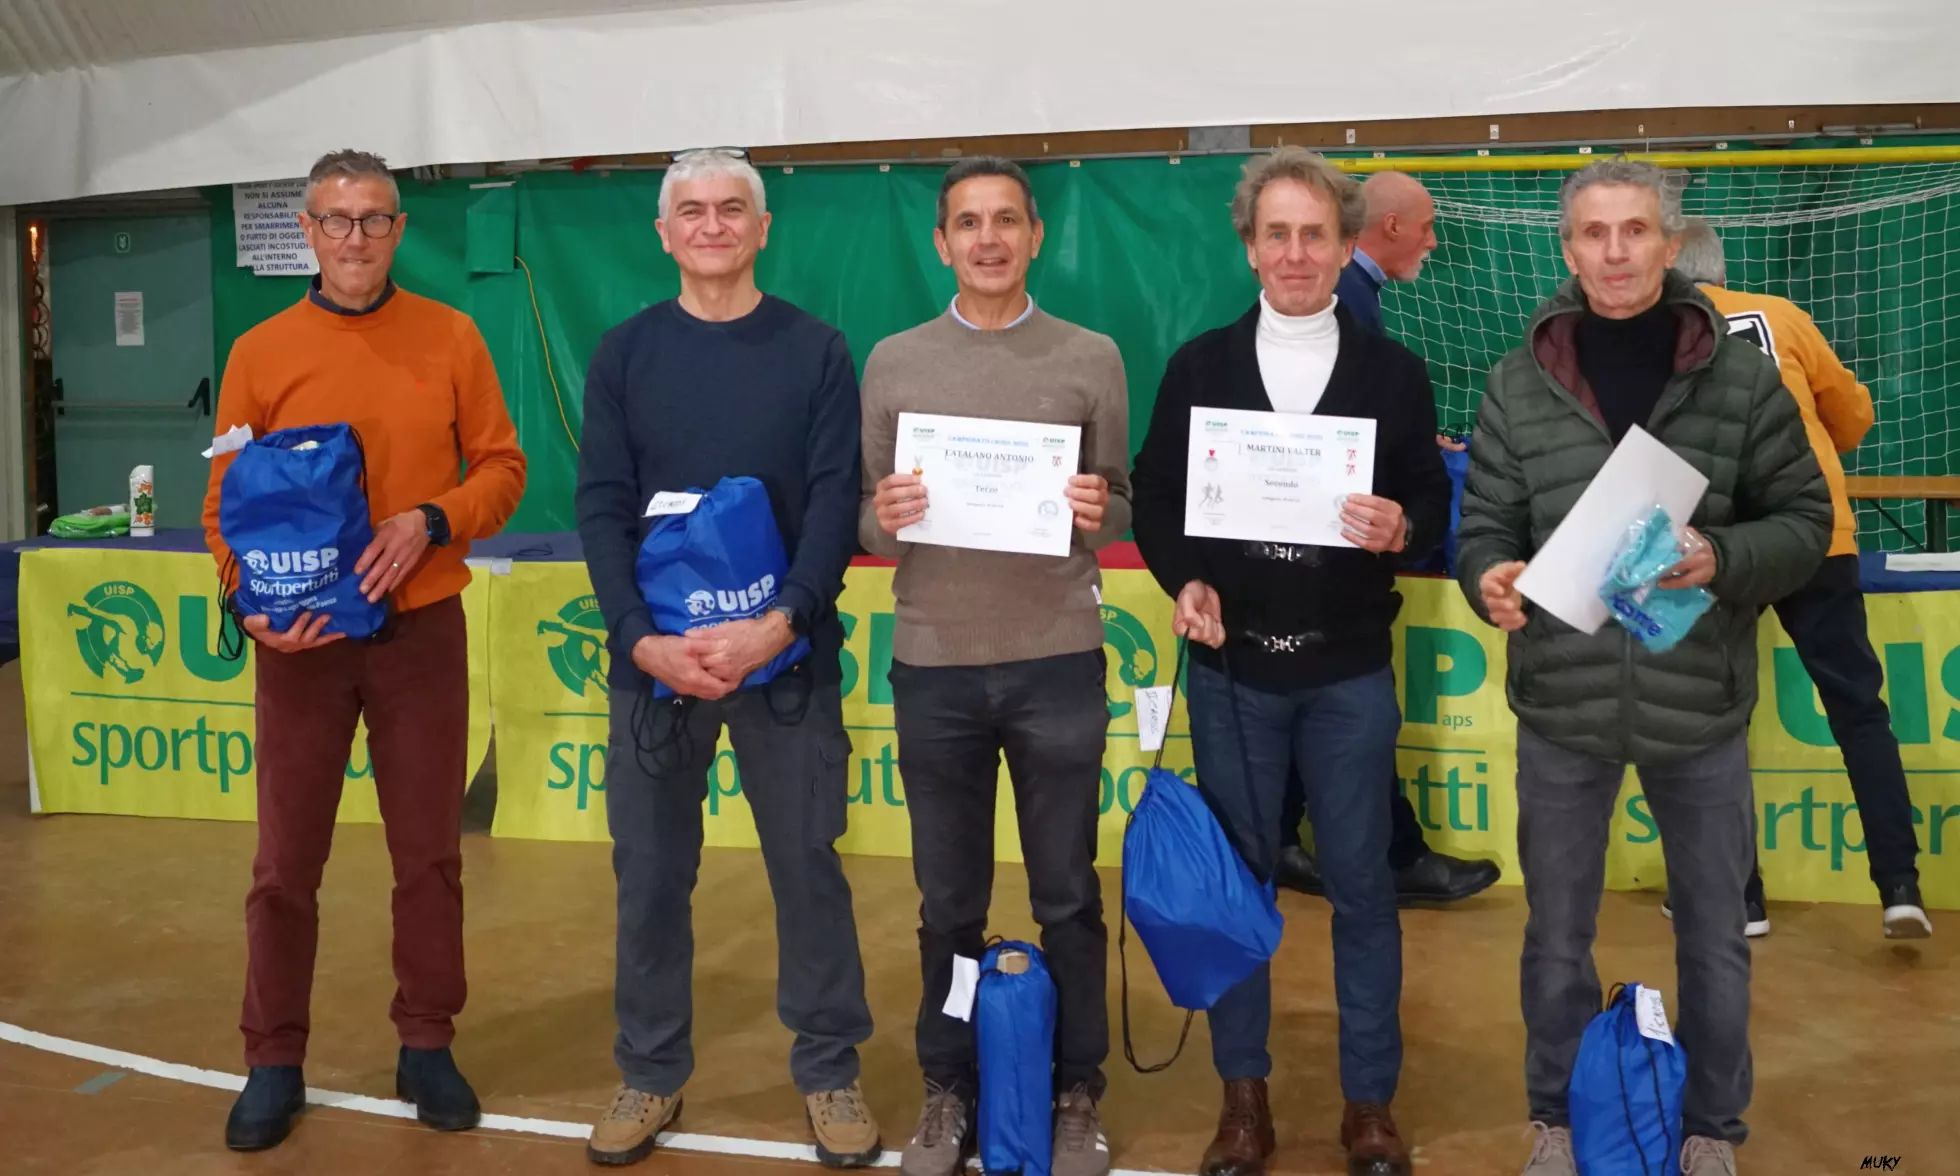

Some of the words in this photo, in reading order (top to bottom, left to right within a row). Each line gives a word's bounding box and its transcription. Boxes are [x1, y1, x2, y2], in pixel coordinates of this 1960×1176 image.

[244, 192, 260, 200] NON
[262, 191, 269, 199] SI
[270, 190, 302, 199] ASSUME
[258, 201, 288, 209] ALCUNA
[243, 211, 298, 220] RESPONSABILIT
[241, 222, 253, 230] PER
[254, 221, 300, 230] SMARRIMEN
[246, 232, 268, 240] FURTO
[269, 232, 277, 240] DI
[279, 231, 305, 240] OGGET
[266, 263, 310, 272] STRUTTURA
[1246, 443, 1285, 454] MARTINI
[994, 452, 1035, 463] ANTONIO
[270, 547, 339, 574] UISP
[103, 584, 135, 596] UISP
[716, 574, 775, 612] UISP
[1441, 713, 1473, 731] aps
